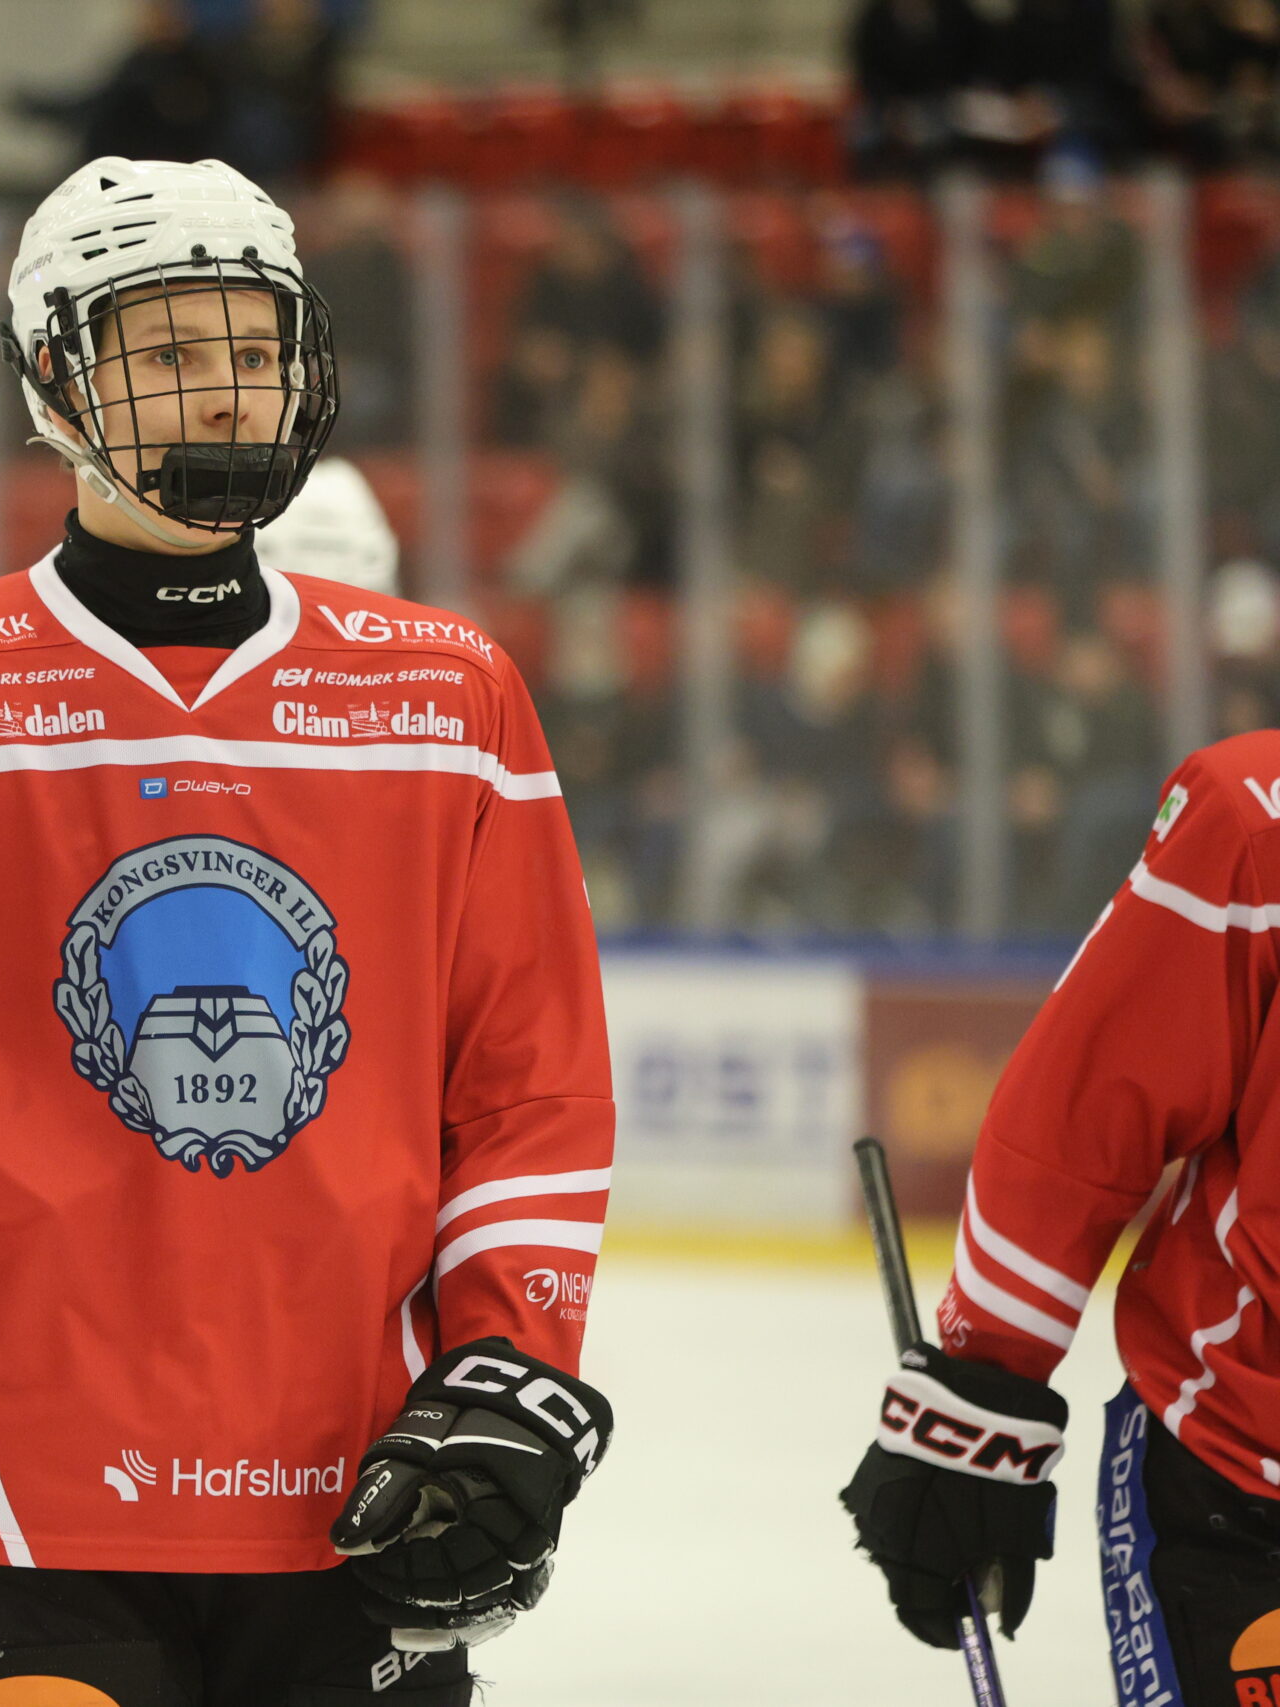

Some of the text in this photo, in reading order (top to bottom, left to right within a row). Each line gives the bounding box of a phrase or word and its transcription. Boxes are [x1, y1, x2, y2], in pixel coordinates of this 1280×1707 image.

[156, 579, 242, 603] CCM
[25, 668, 96, 684] SERVICE
[315, 671, 394, 687] HEDMARK
[396, 669, 465, 685] SERVICE
[91, 850, 317, 934] KONGSVINGER IL
[174, 1073, 258, 1105] 1892
[407, 1410, 444, 1420] PRO
[442, 1355, 599, 1484] CCM
[880, 1385, 1061, 1481] CCM
[172, 1456, 345, 1496] Hafslund
[351, 1469, 393, 1527] CCM
